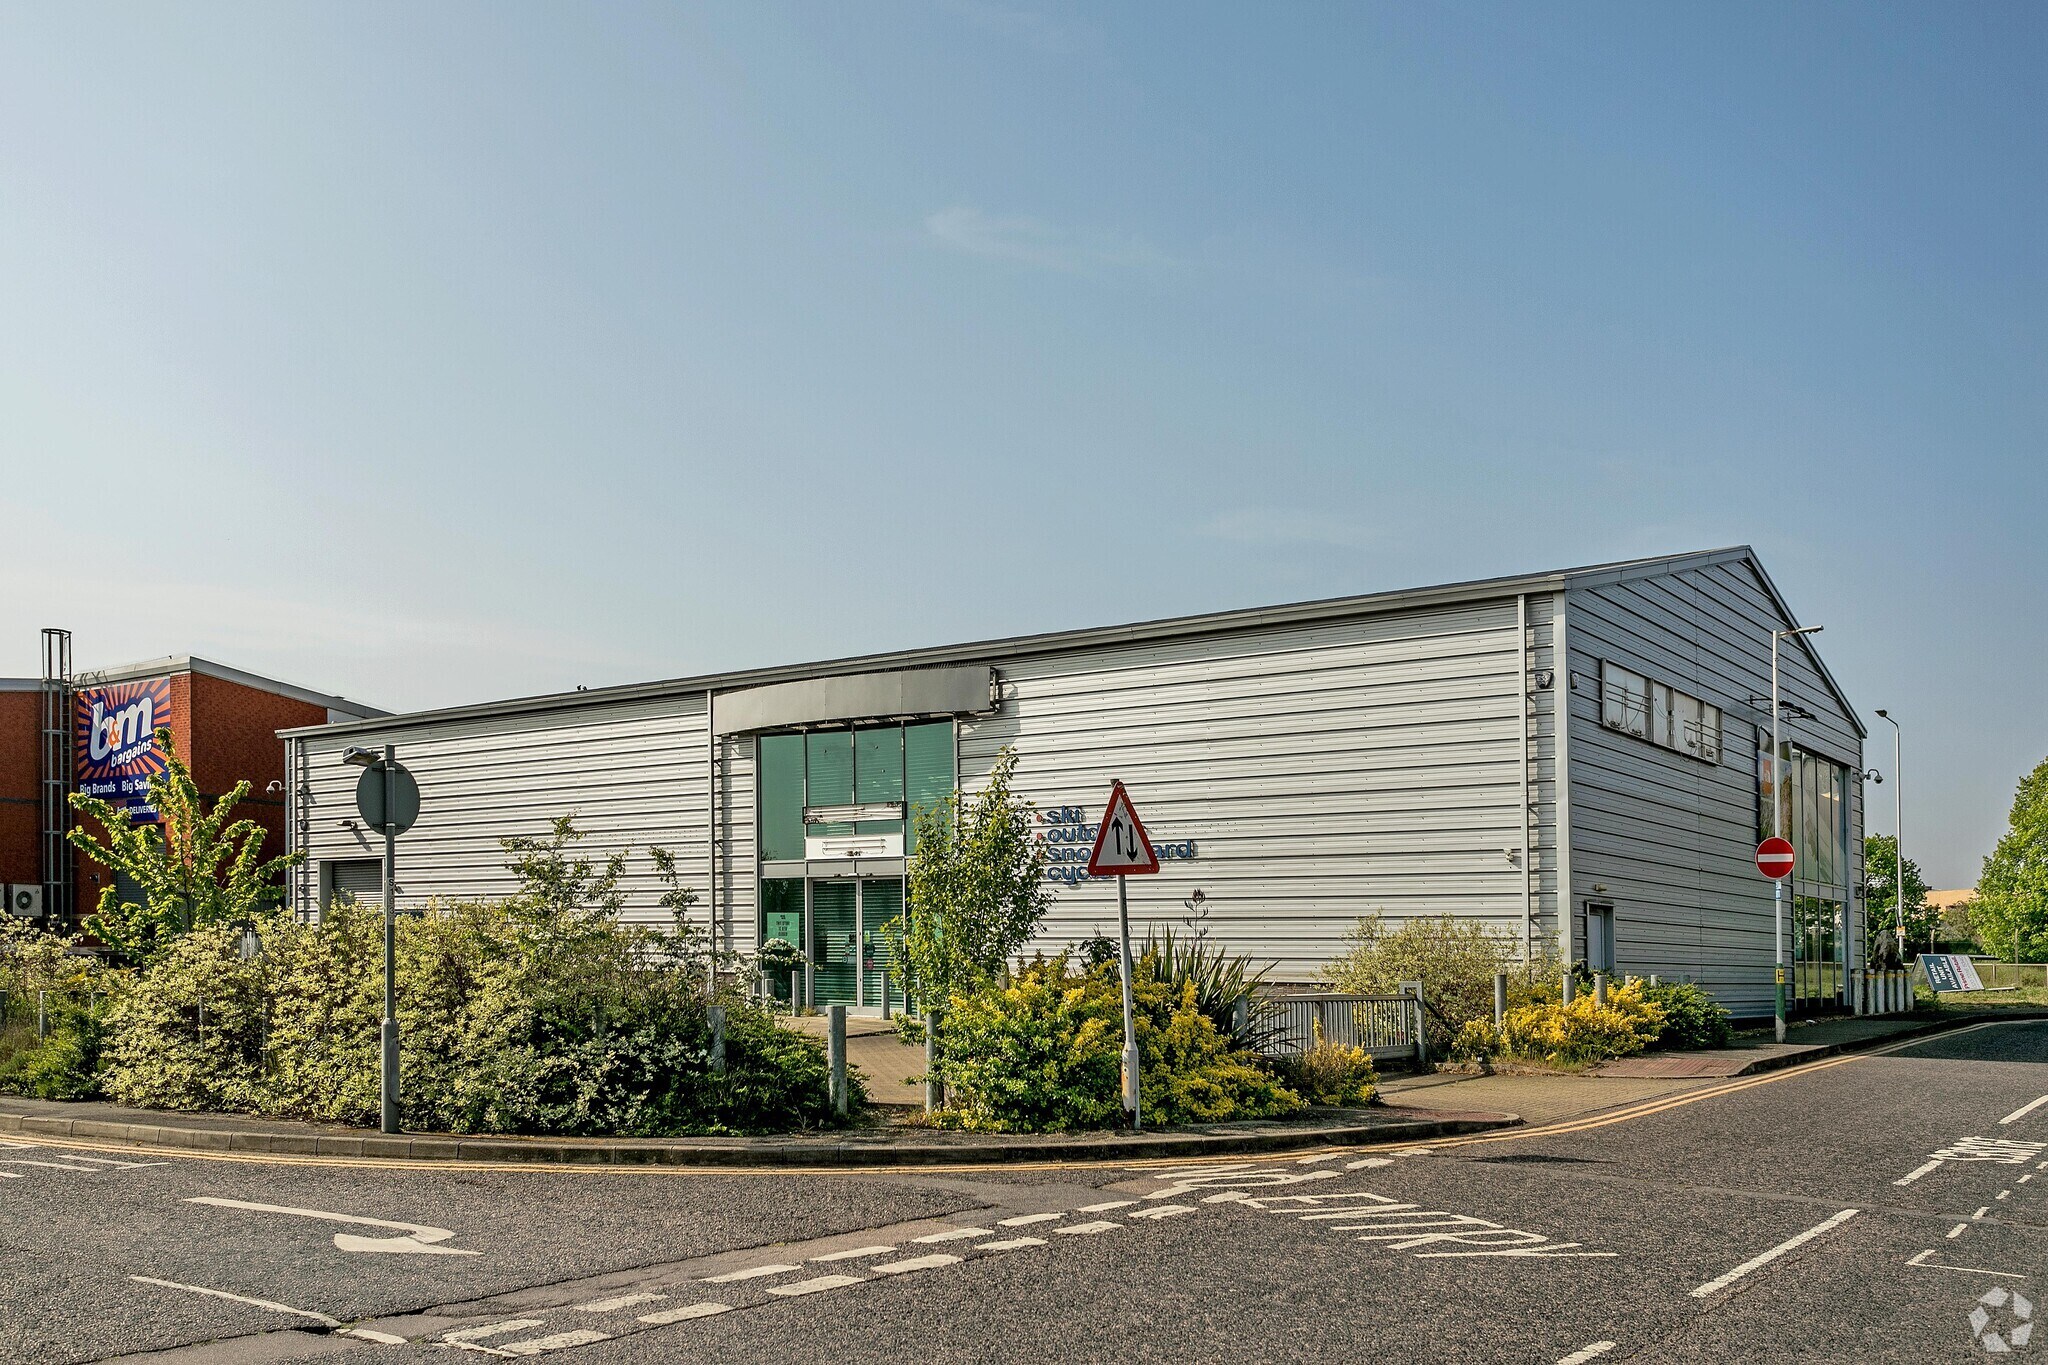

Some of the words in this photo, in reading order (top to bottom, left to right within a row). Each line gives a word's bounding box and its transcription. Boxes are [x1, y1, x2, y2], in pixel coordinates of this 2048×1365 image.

[90, 697, 154, 761] b&m
[111, 739, 152, 768] bargains
[80, 783, 91, 797] Big
[92, 781, 116, 794] Brands
[121, 780, 133, 793] Big
[1047, 805, 1080, 824] ski
[1048, 839, 1193, 862] snoard
[1929, 962, 1942, 984] RETAIL
[1936, 965, 1947, 980] UNIT
[1940, 956, 1959, 989] AVAILABLE
[1236, 1192, 1619, 1258] ENTRY
